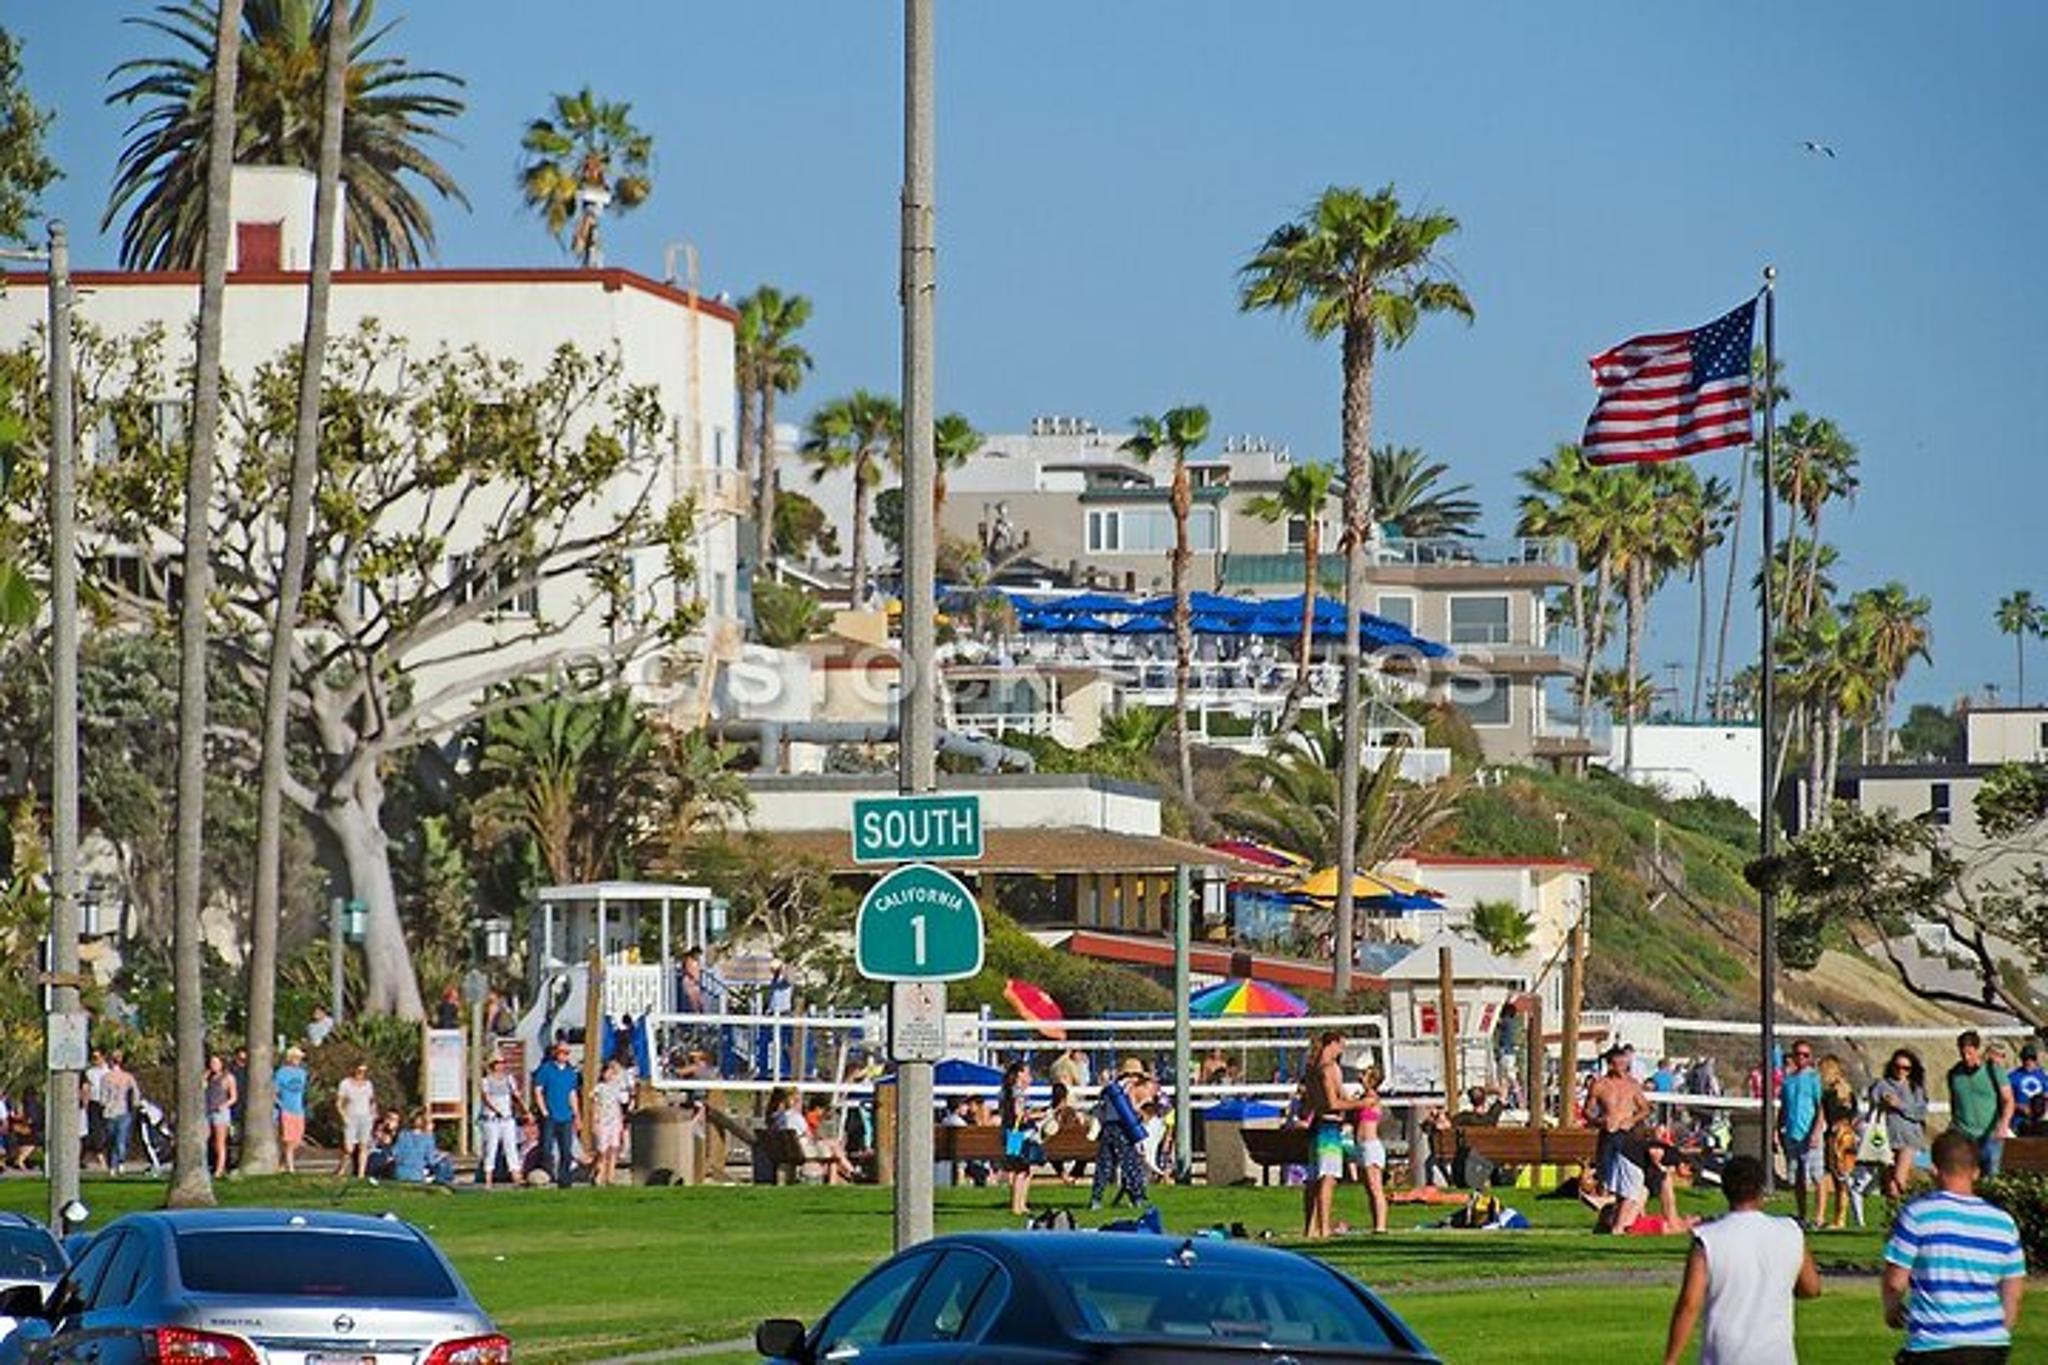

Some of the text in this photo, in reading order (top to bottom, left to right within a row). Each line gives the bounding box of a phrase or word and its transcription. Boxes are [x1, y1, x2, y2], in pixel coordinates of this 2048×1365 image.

[863, 807, 973, 849] SOUTH
[875, 887, 963, 912] CALIFORNIA
[910, 915, 925, 965] 1
